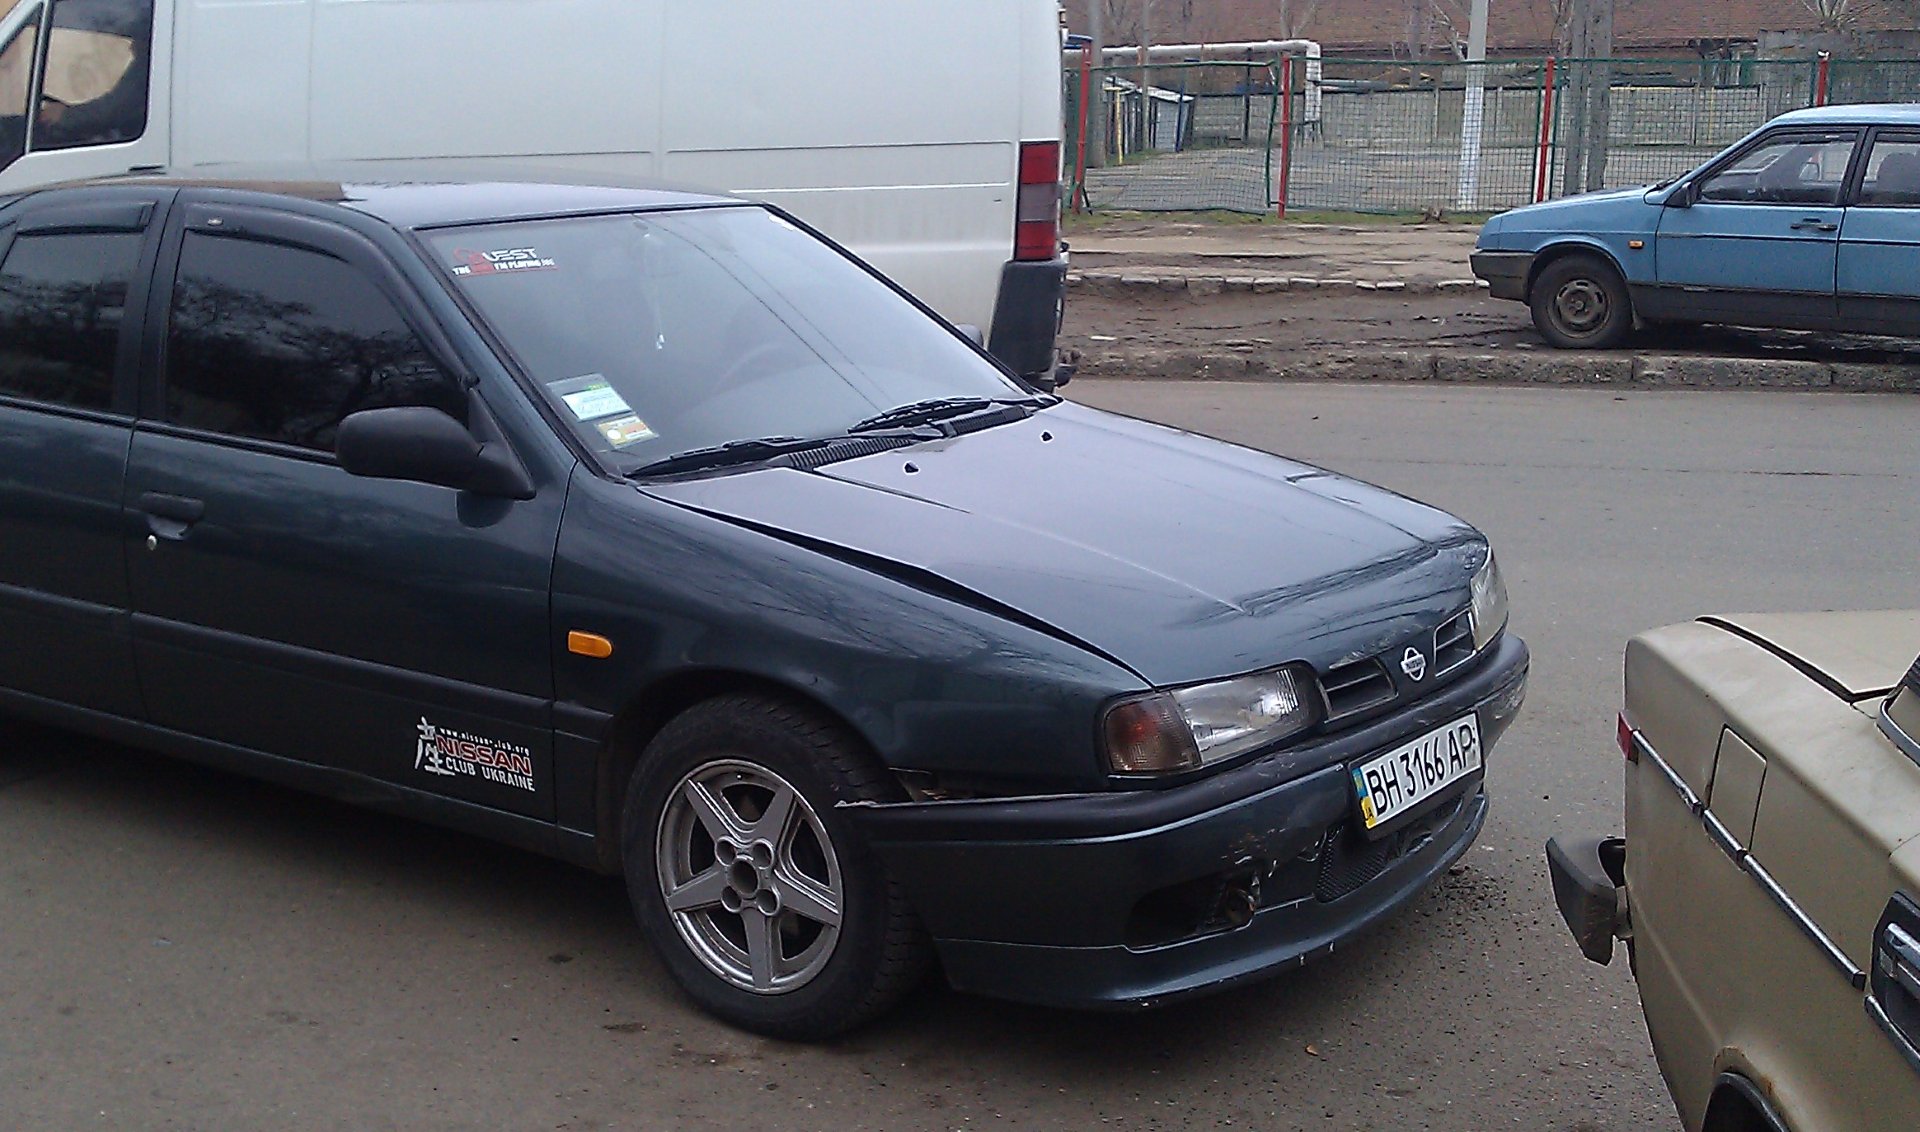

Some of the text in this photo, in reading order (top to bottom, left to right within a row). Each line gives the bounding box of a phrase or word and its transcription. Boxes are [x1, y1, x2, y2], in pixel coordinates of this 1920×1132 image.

[435, 734, 533, 777] NISSAN
[445, 757, 536, 791] CLUB UKRAINE
[1365, 724, 1473, 816] BH 3166 AP
